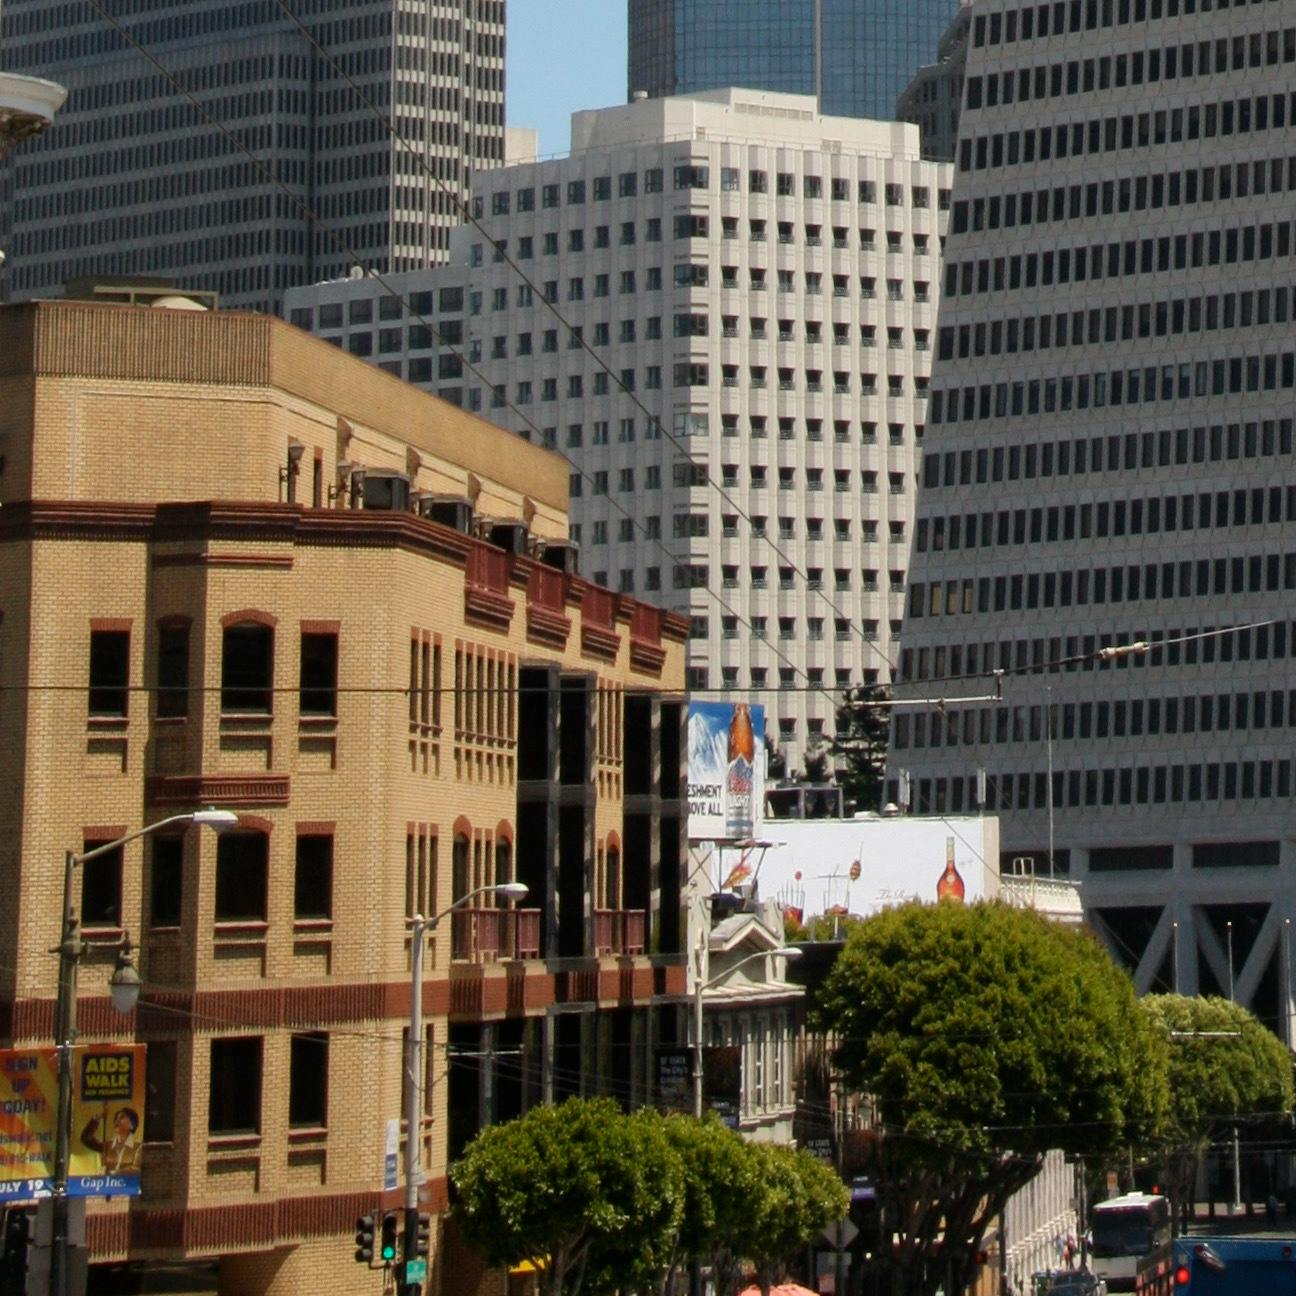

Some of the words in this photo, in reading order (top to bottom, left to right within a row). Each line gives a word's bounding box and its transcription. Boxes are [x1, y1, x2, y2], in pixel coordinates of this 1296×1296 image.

[86, 1056, 129, 1073] AIDS
[86, 1073, 129, 1088] WALK
[28, 1179, 44, 1191] 19
[81, 1177, 104, 1191] Gap
[105, 1176, 126, 1187] Inc.
